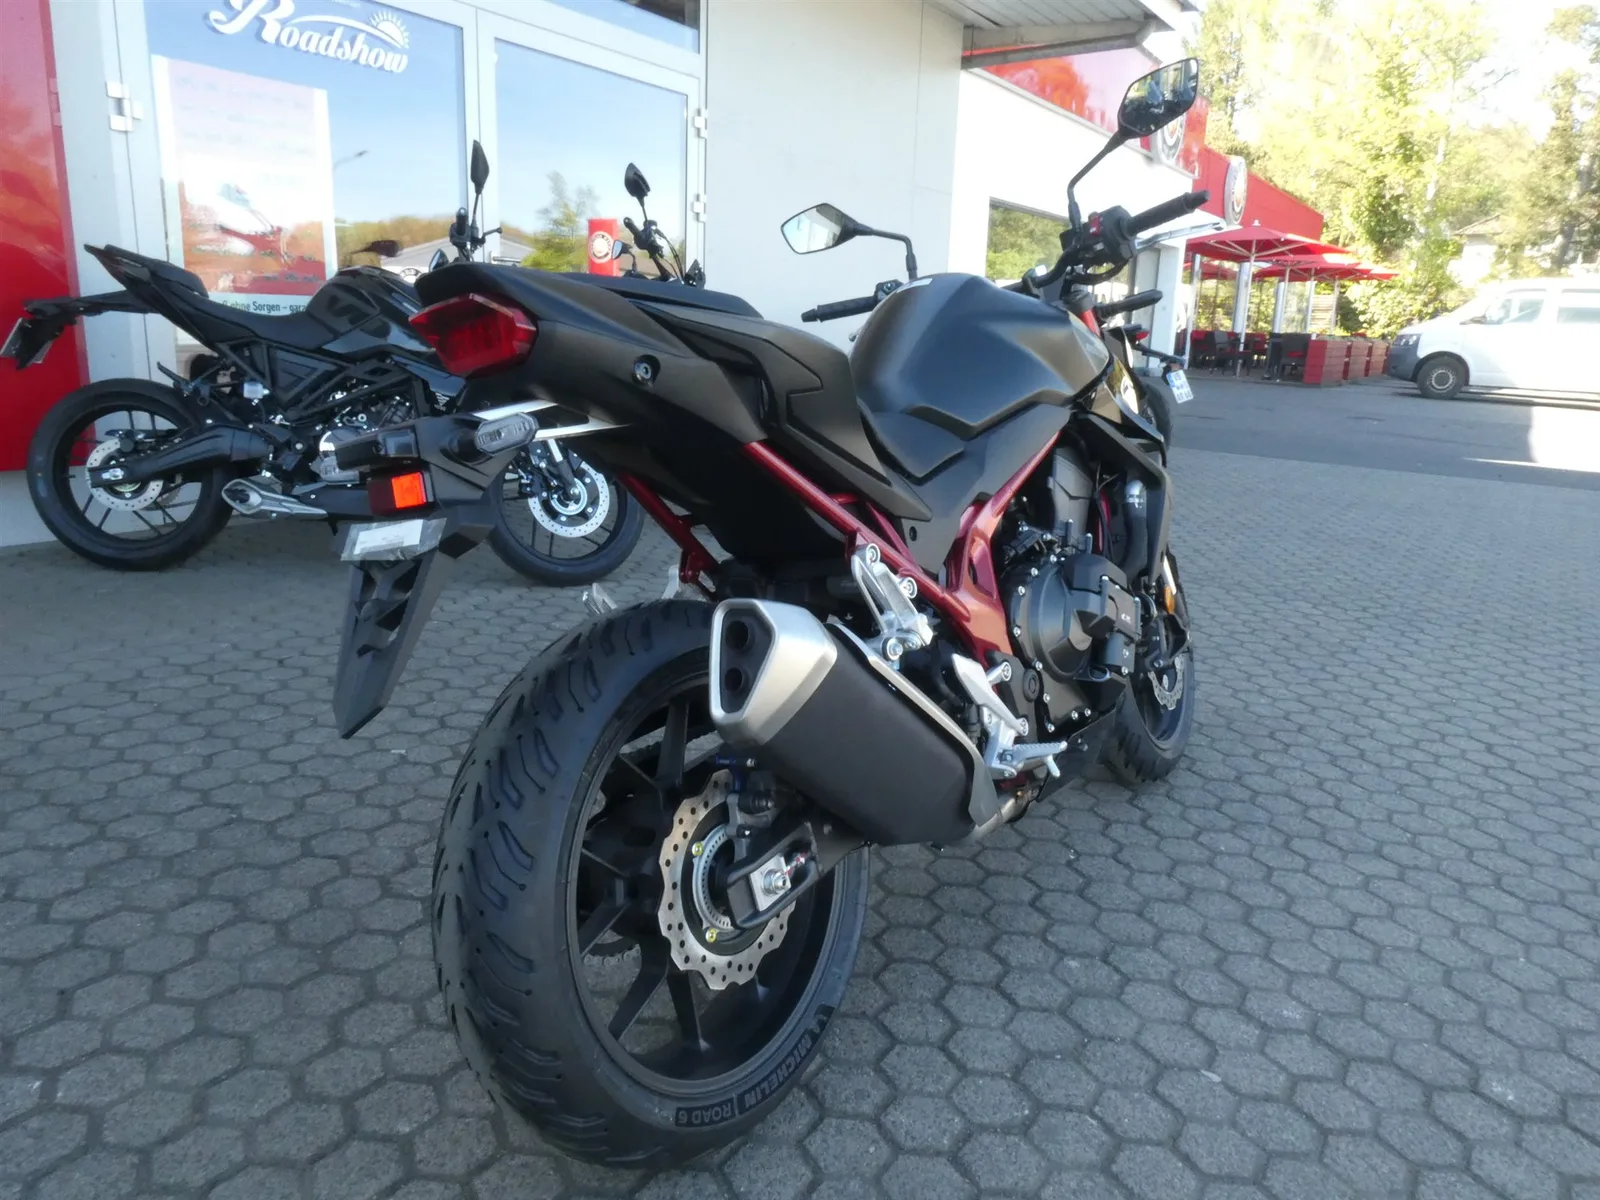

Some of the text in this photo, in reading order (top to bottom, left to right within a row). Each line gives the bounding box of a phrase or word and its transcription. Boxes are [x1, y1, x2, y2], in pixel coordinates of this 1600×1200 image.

[207, 0, 408, 73] Roadshow
[252, 301, 280, 313] Sorgen
[677, 1033, 813, 1124] MICHELIN ROAD 6
